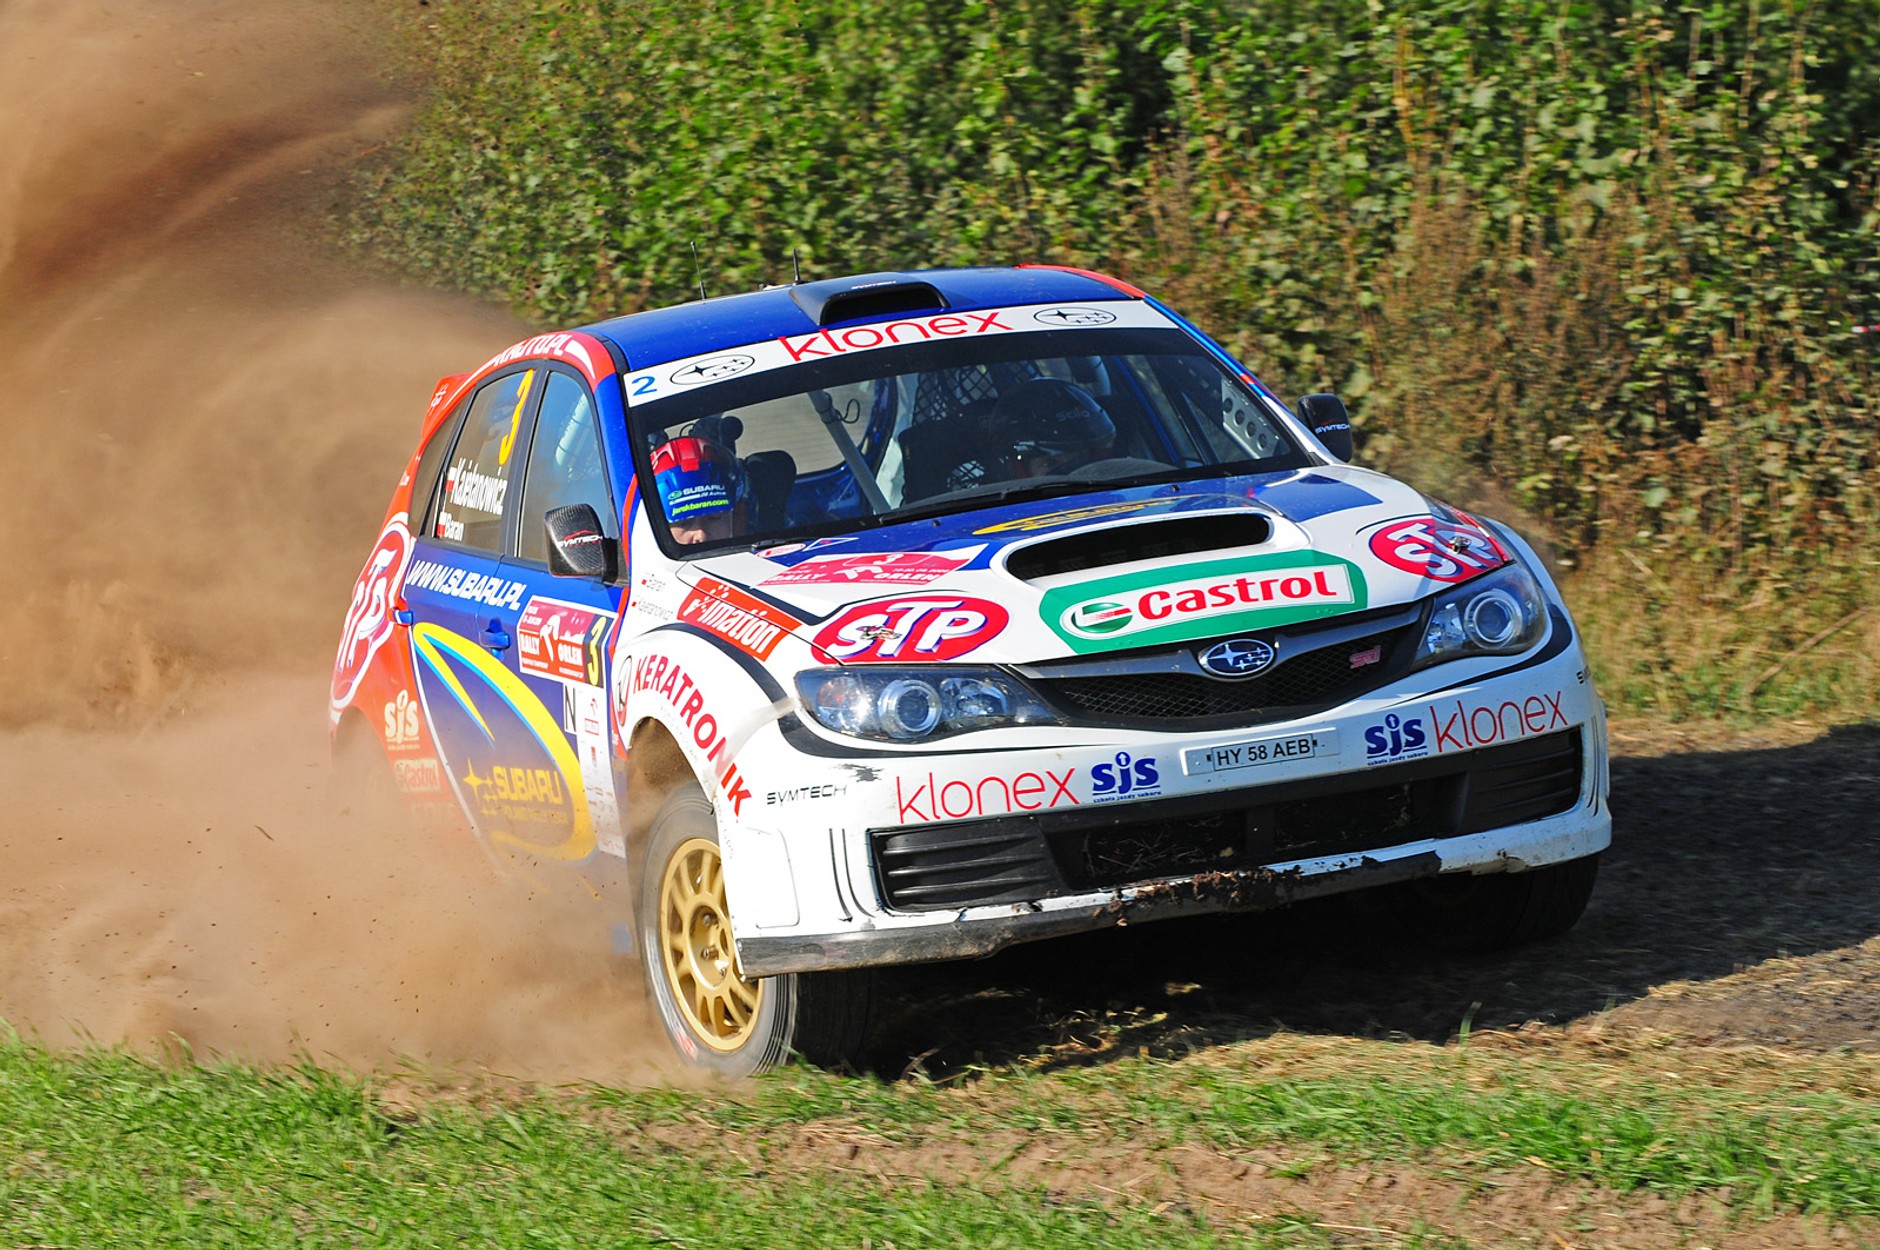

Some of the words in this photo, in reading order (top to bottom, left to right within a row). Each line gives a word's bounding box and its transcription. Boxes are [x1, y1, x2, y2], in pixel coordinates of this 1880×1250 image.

[777, 311, 1014, 362] klonex
[631, 375, 658, 397] 2
[499, 369, 534, 465] 3
[450, 457, 508, 516] Kajetanowicz
[671, 499, 729, 516] jarekbaran.com
[682, 485, 725, 496] SUBARU
[1386, 523, 1494, 577] STP
[405, 560, 527, 612] WWW.SUBARU.PL
[1137, 571, 1337, 620] Castrol
[587, 616, 607, 686] 3
[823, 600, 988, 658] STP
[565, 684, 577, 733] N
[1364, 713, 1426, 757] sjs
[1429, 690, 1568, 753] klonex
[633, 654, 753, 817] KERATRONIK
[1217, 748, 1241, 766] HY
[1248, 744, 1268, 762] 58
[1273, 739, 1310, 759] AEB
[493, 765, 563, 806] SUBARU
[896, 767, 1081, 825] klonex
[1090, 751, 1159, 795] sjs
